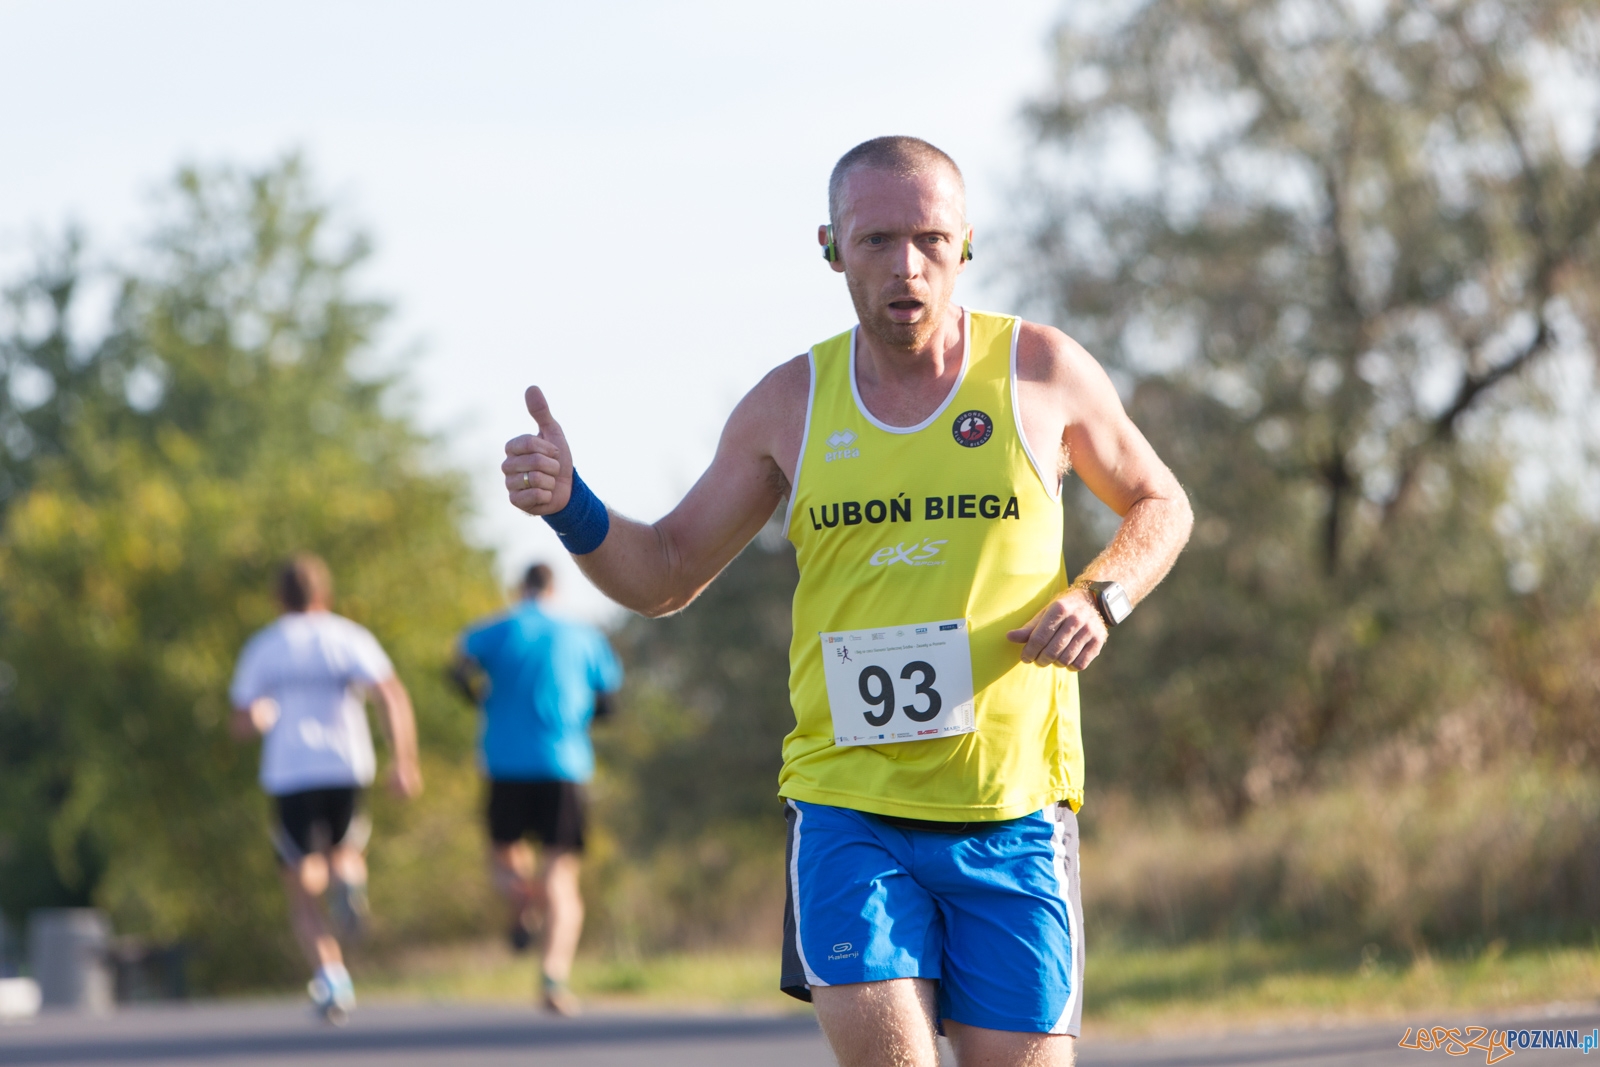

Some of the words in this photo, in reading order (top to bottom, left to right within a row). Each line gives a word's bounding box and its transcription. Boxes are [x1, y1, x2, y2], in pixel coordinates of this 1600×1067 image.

[809, 492, 912, 531] LUBOŃ
[924, 494, 1020, 520] BIEGA
[858, 660, 942, 727] 93
[827, 950, 859, 961] Kalenji
